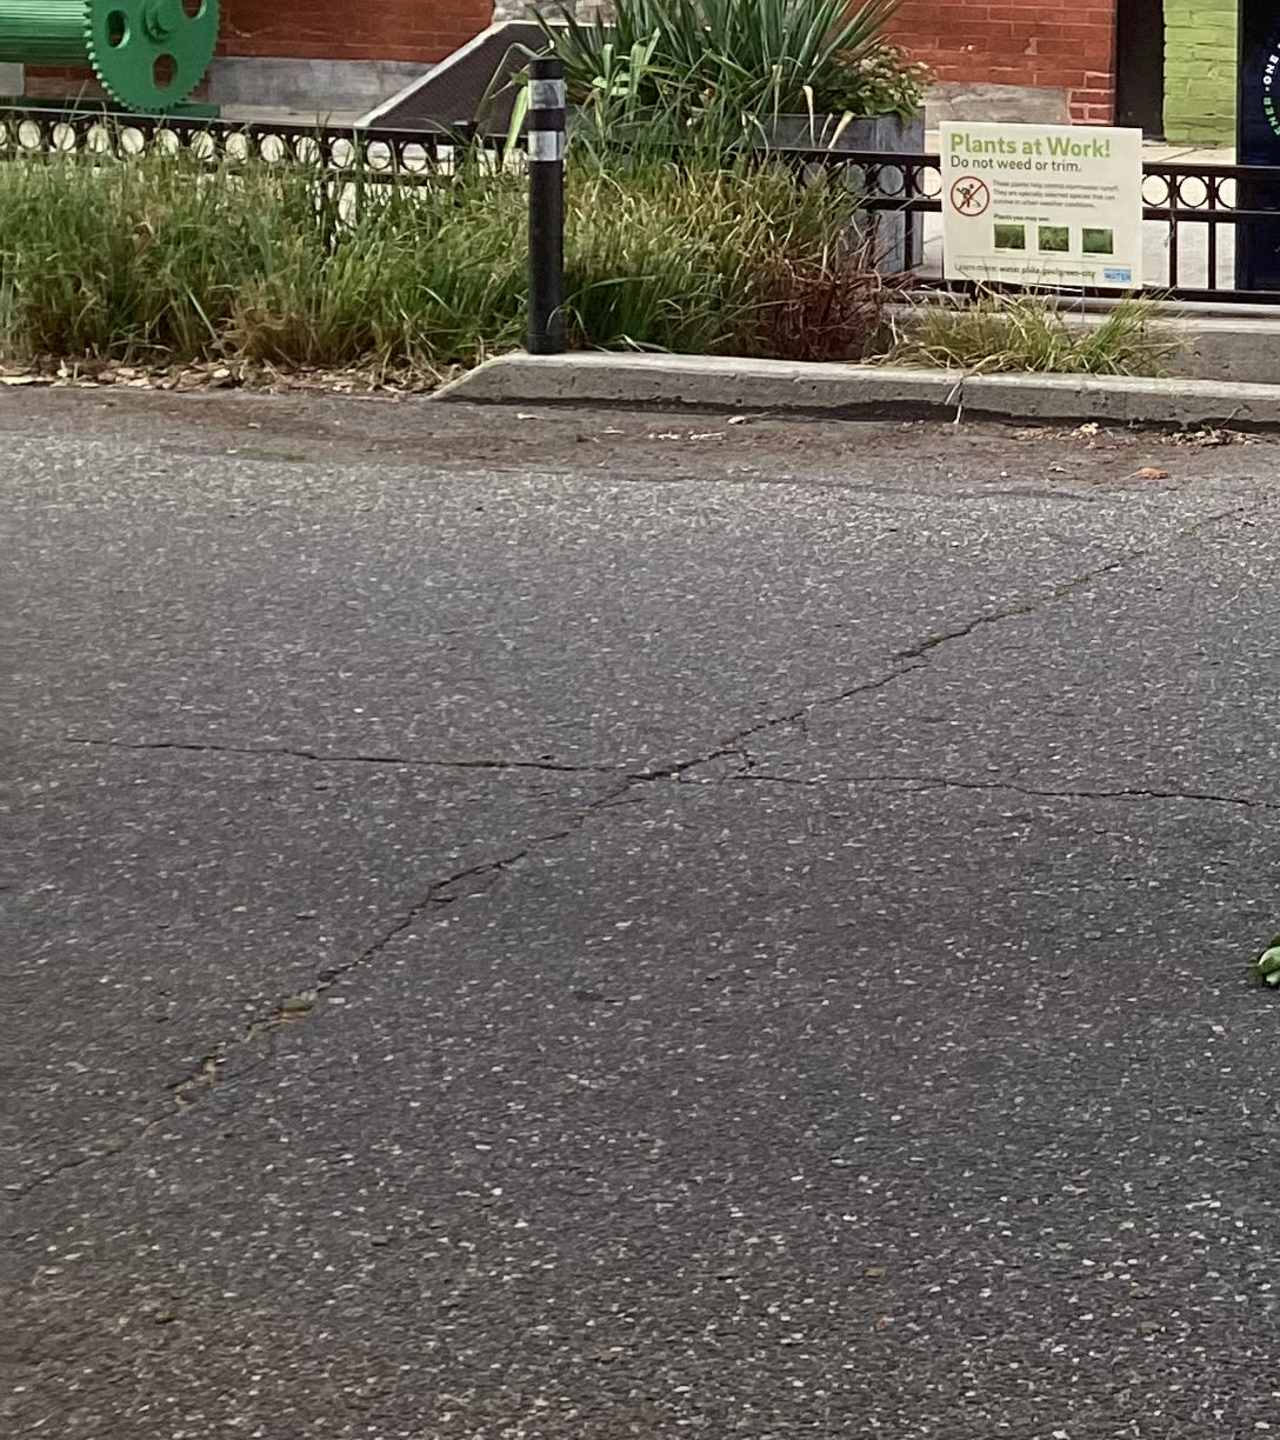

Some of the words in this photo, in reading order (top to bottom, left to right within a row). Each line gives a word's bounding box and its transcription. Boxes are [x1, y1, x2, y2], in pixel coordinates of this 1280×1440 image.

[1263, 54, 1279, 86] ONE
[950, 133, 1017, 155] Plants
[1022, 138, 1042, 155] at
[1046, 137, 1111, 158] Work!
[951, 155, 968, 168] Do
[972, 157, 994, 169] not
[997, 158, 1031, 171] weed
[1035, 160, 1048, 171] or
[1051, 161, 1082, 173] trim.
